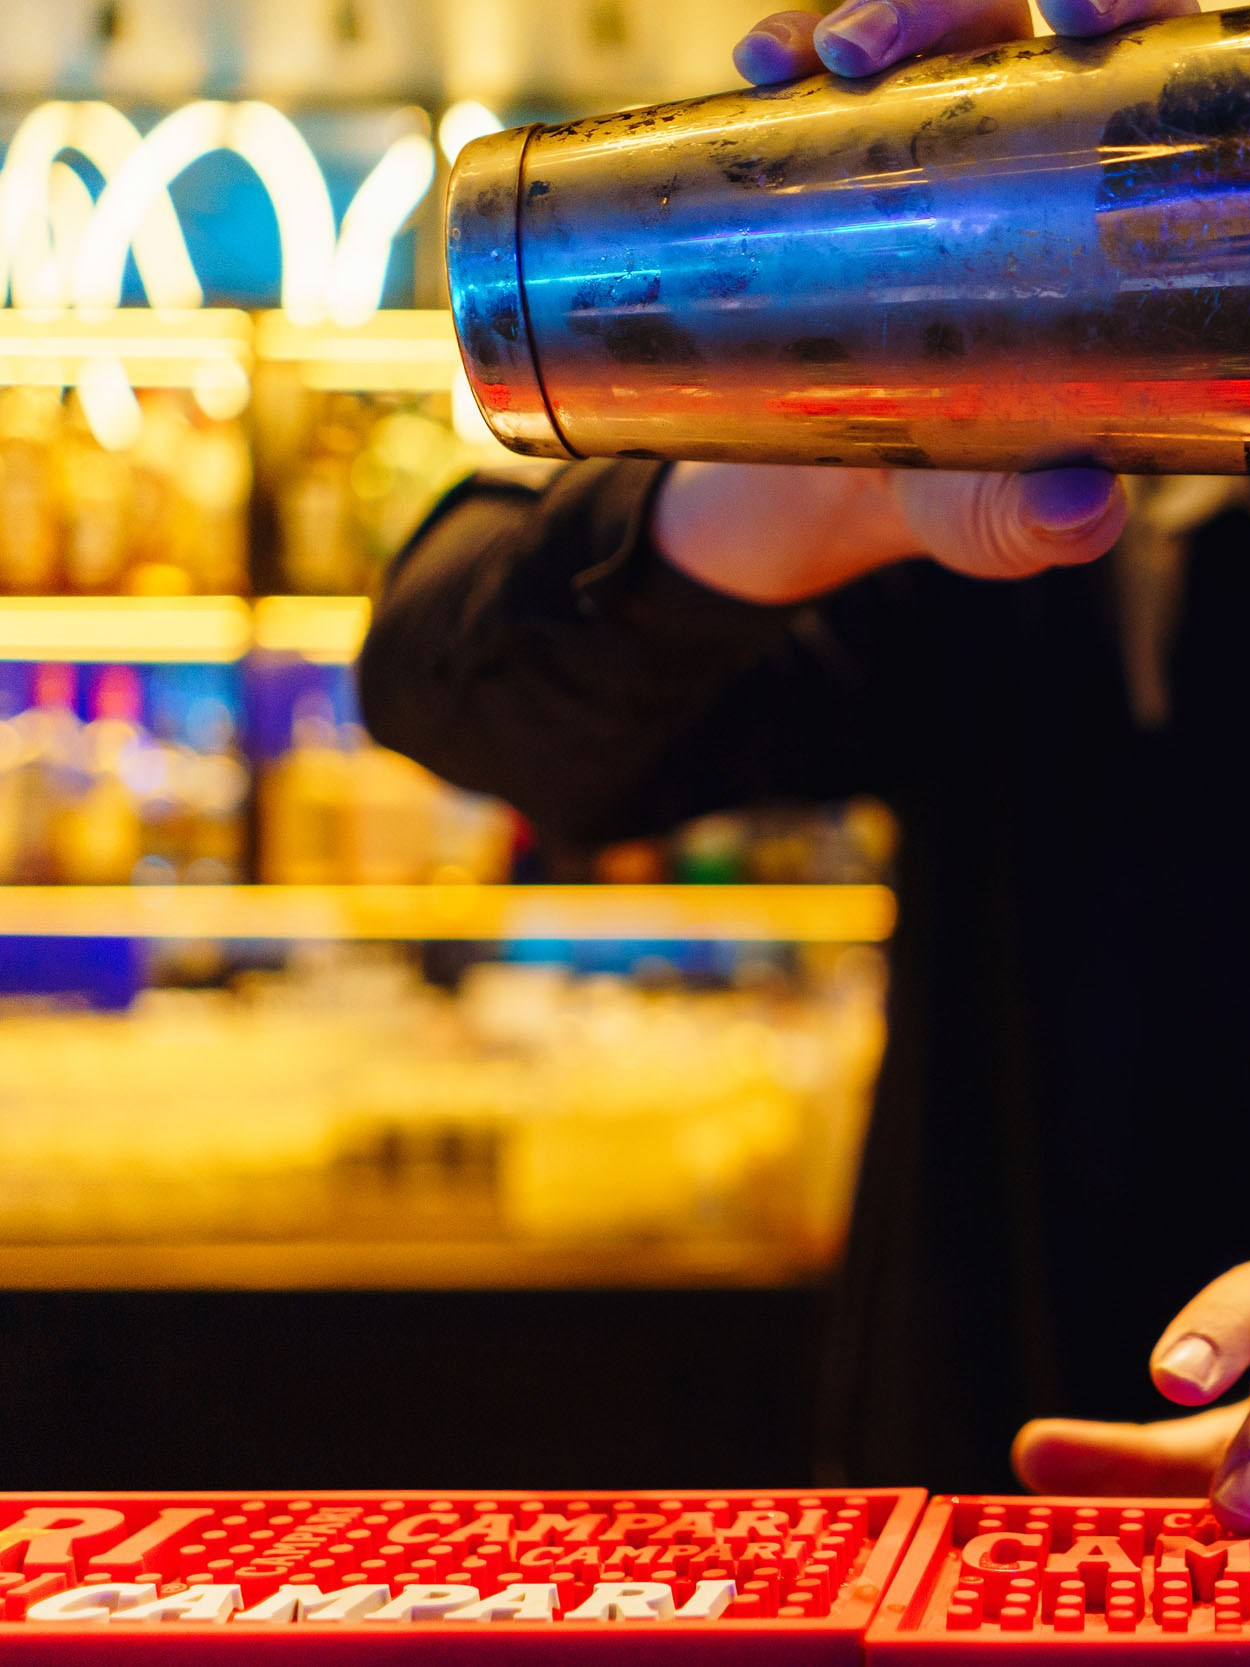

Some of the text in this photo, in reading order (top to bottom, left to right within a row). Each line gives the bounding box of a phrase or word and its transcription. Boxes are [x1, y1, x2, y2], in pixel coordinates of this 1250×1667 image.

[387, 1508, 829, 1542] CAMPARI
[519, 1541, 806, 1566] CAMPARI
[27, 1579, 738, 1621] CAMPARI
